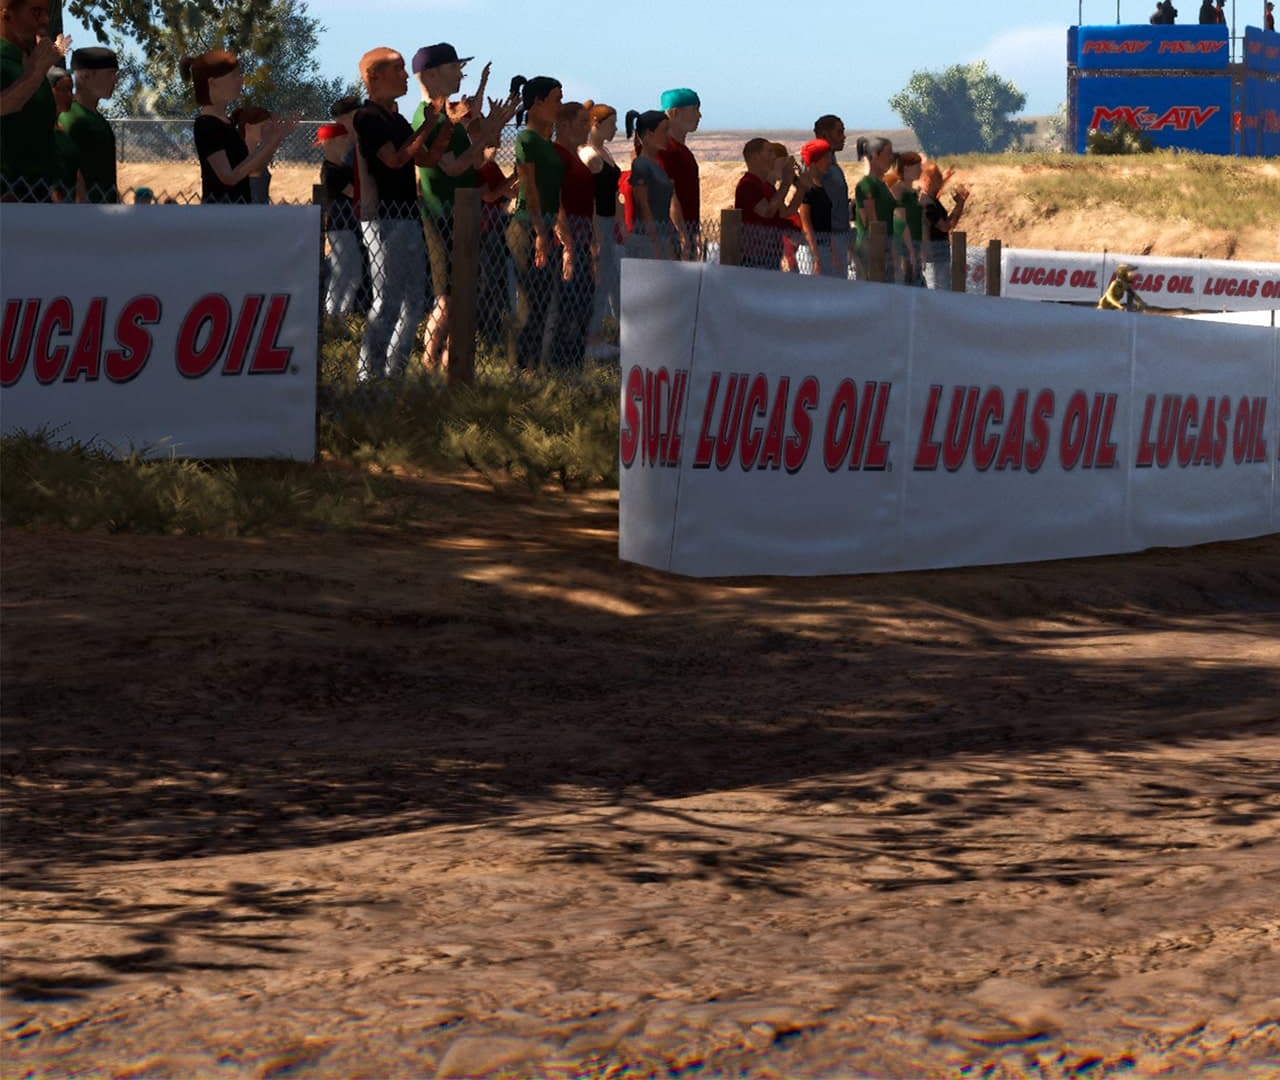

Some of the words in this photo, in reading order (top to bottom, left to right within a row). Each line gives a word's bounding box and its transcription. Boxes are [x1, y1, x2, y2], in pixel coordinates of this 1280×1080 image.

[1009, 266, 1067, 287] LUCAS
[1069, 270, 1098, 288] OIL
[1109, 270, 1164, 292] CAS
[1167, 275, 1194, 293] OIL
[1203, 277, 1259, 297] LUCAS
[175, 293, 292, 380] OIL
[692, 372, 820, 474] LUCAS
[824, 378, 891, 472] OIL
[913, 384, 1055, 473] LUCAS
[1059, 390, 1118, 471] OIL
[1135, 393, 1231, 470] LUCAS
[1233, 396, 1268, 465] OIL
